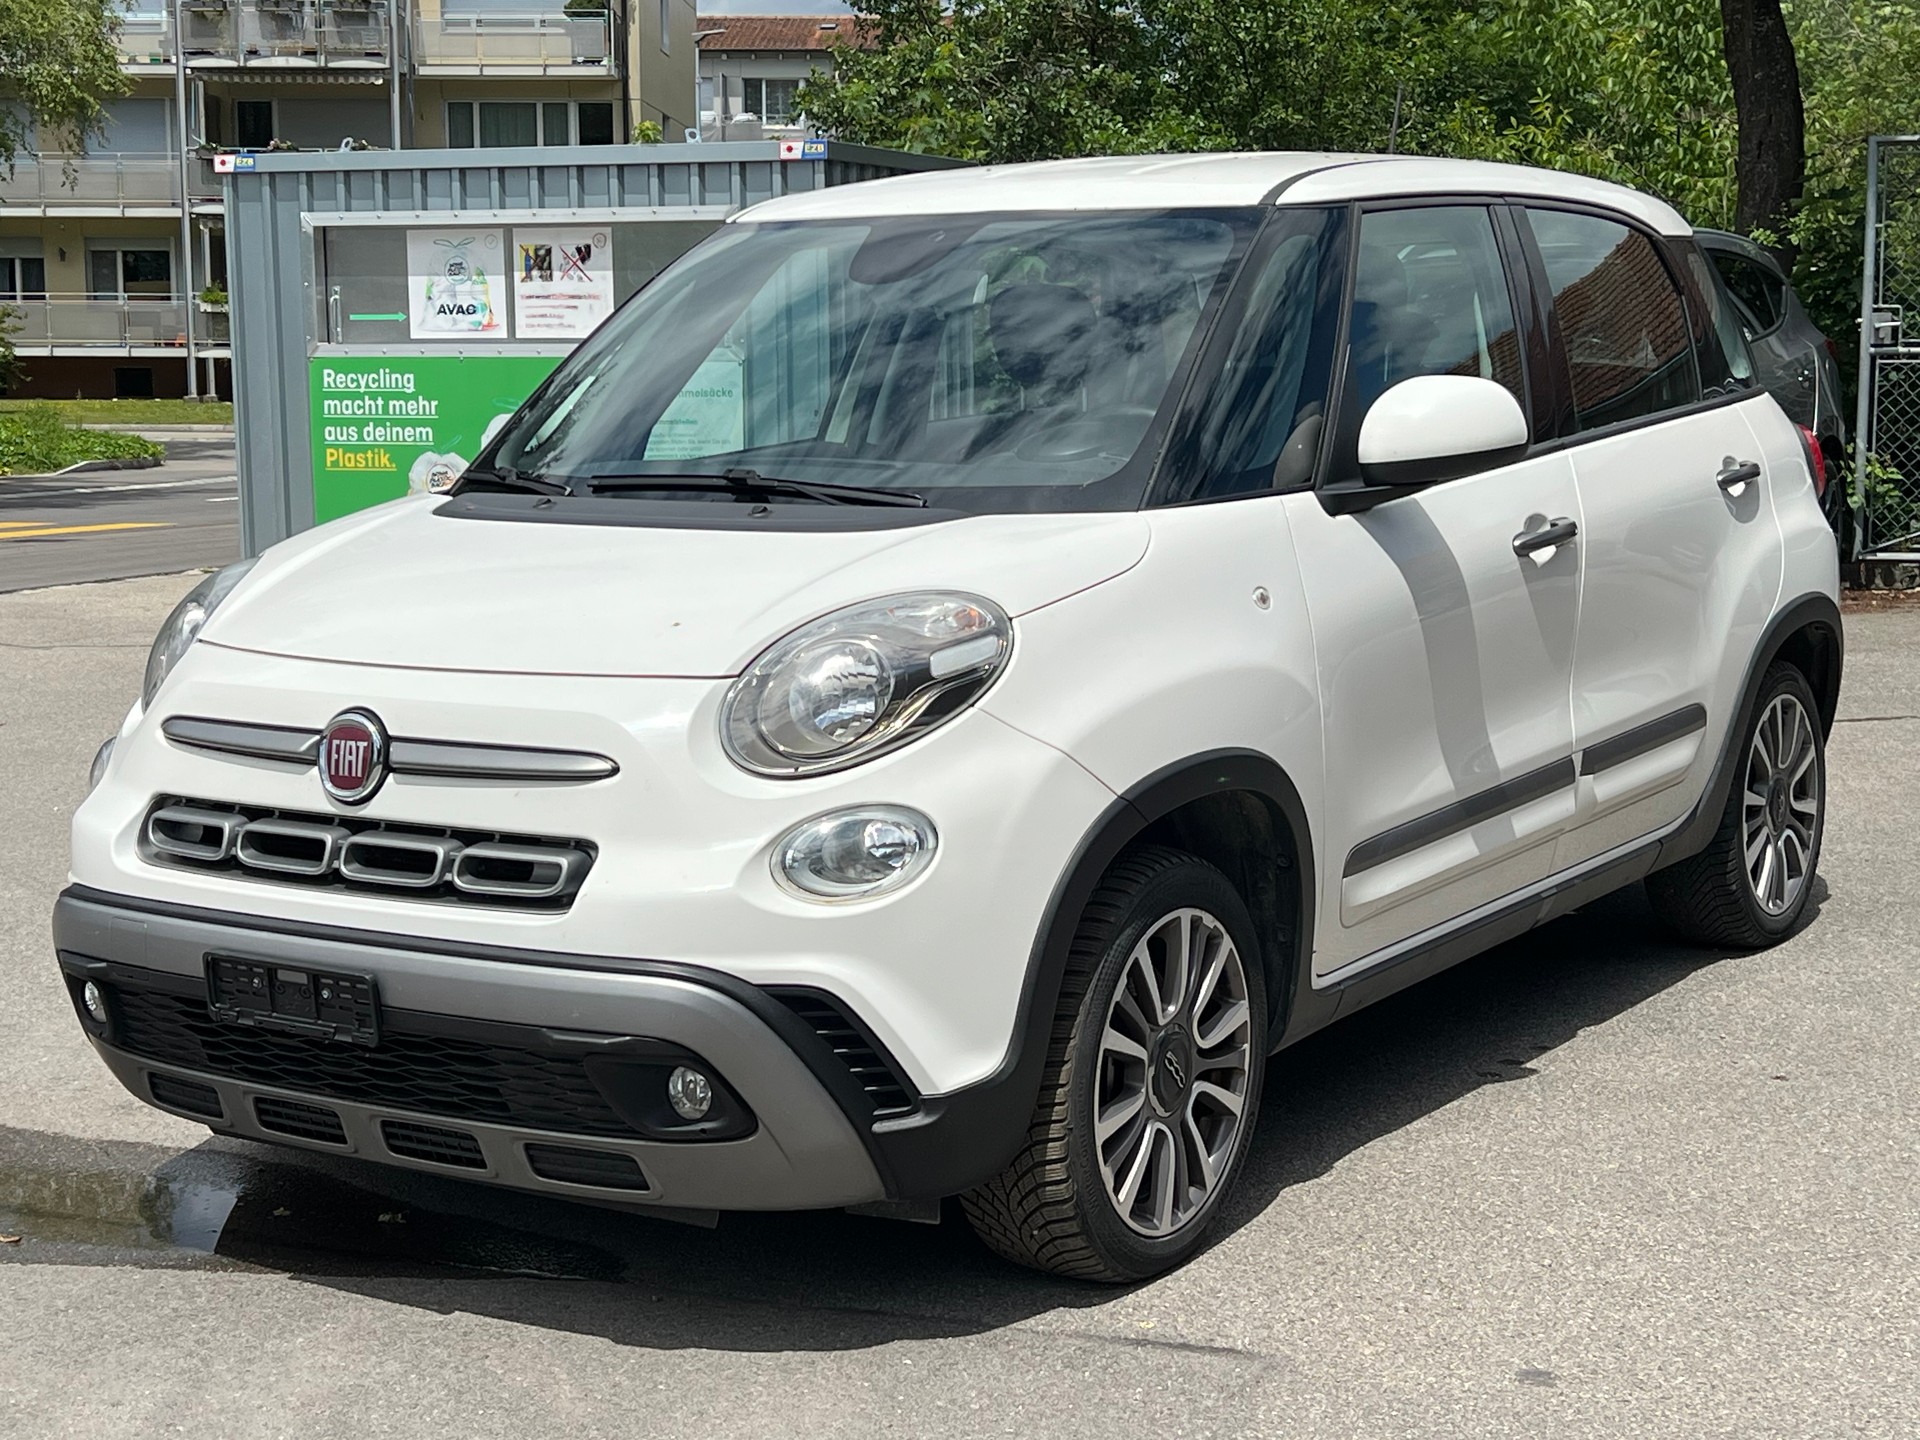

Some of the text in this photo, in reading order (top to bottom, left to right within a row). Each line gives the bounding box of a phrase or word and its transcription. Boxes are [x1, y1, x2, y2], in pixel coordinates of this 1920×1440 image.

[322, 368, 415, 393] Recycling
[323, 395, 438, 415] macht mehr
[324, 422, 433, 442] aus deinem
[325, 448, 397, 468] Plastik.
[330, 739, 368, 778] FIAT
